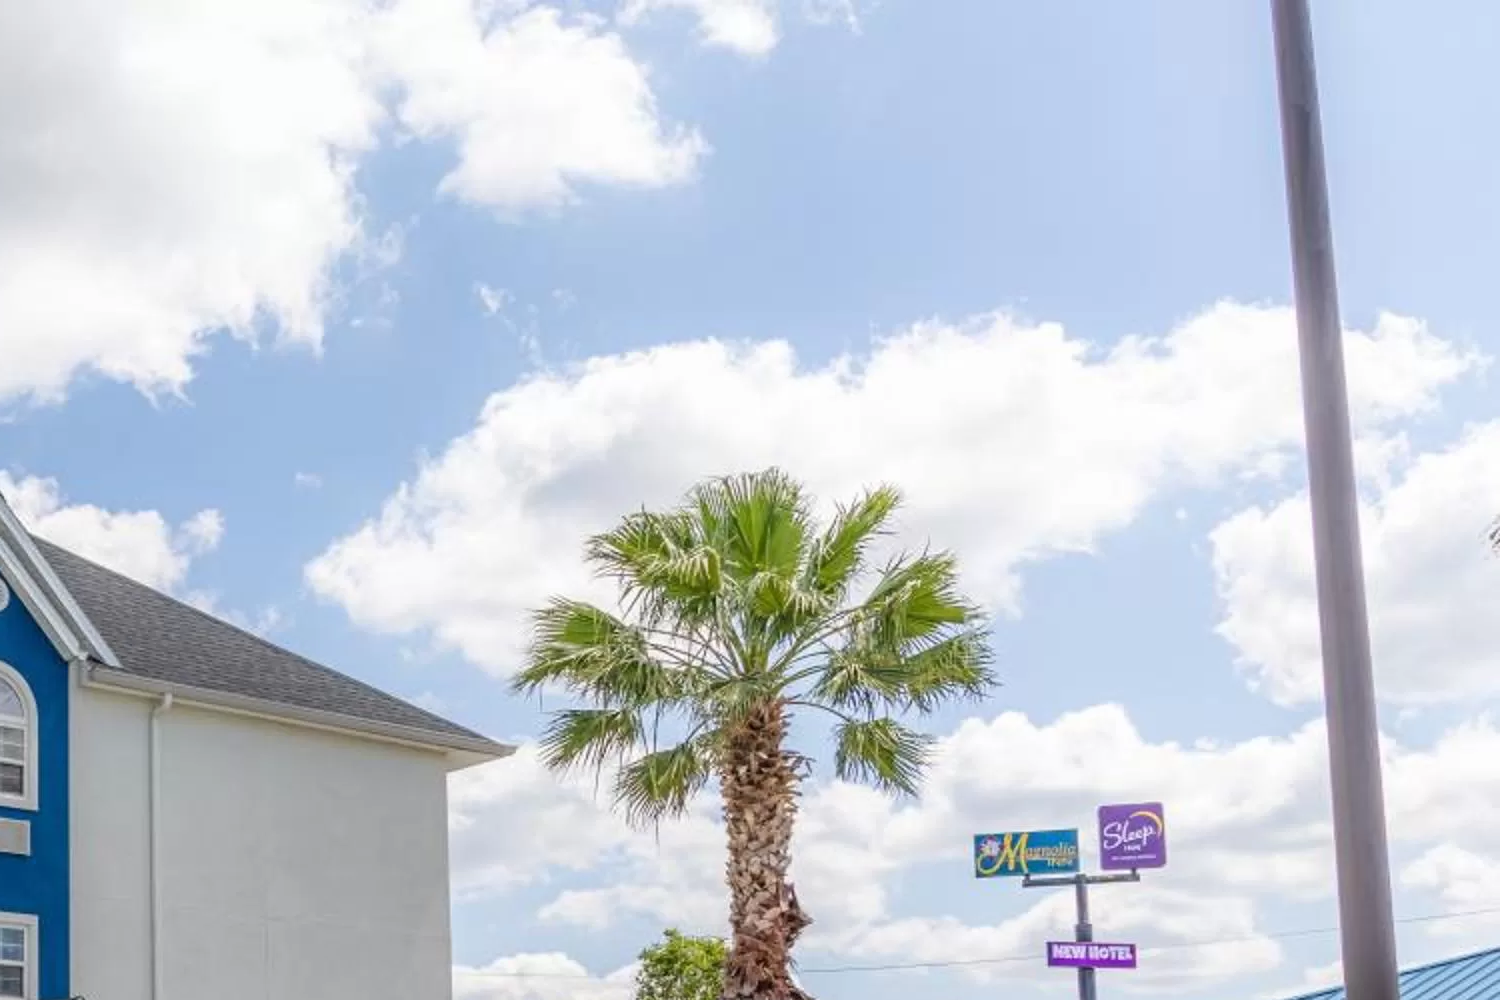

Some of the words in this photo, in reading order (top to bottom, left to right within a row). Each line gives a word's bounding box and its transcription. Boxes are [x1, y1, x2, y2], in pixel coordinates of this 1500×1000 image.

[1103, 819, 1156, 850] Sleep
[1052, 944, 1087, 959] NEW
[1088, 945, 1133, 961] HOTEL
